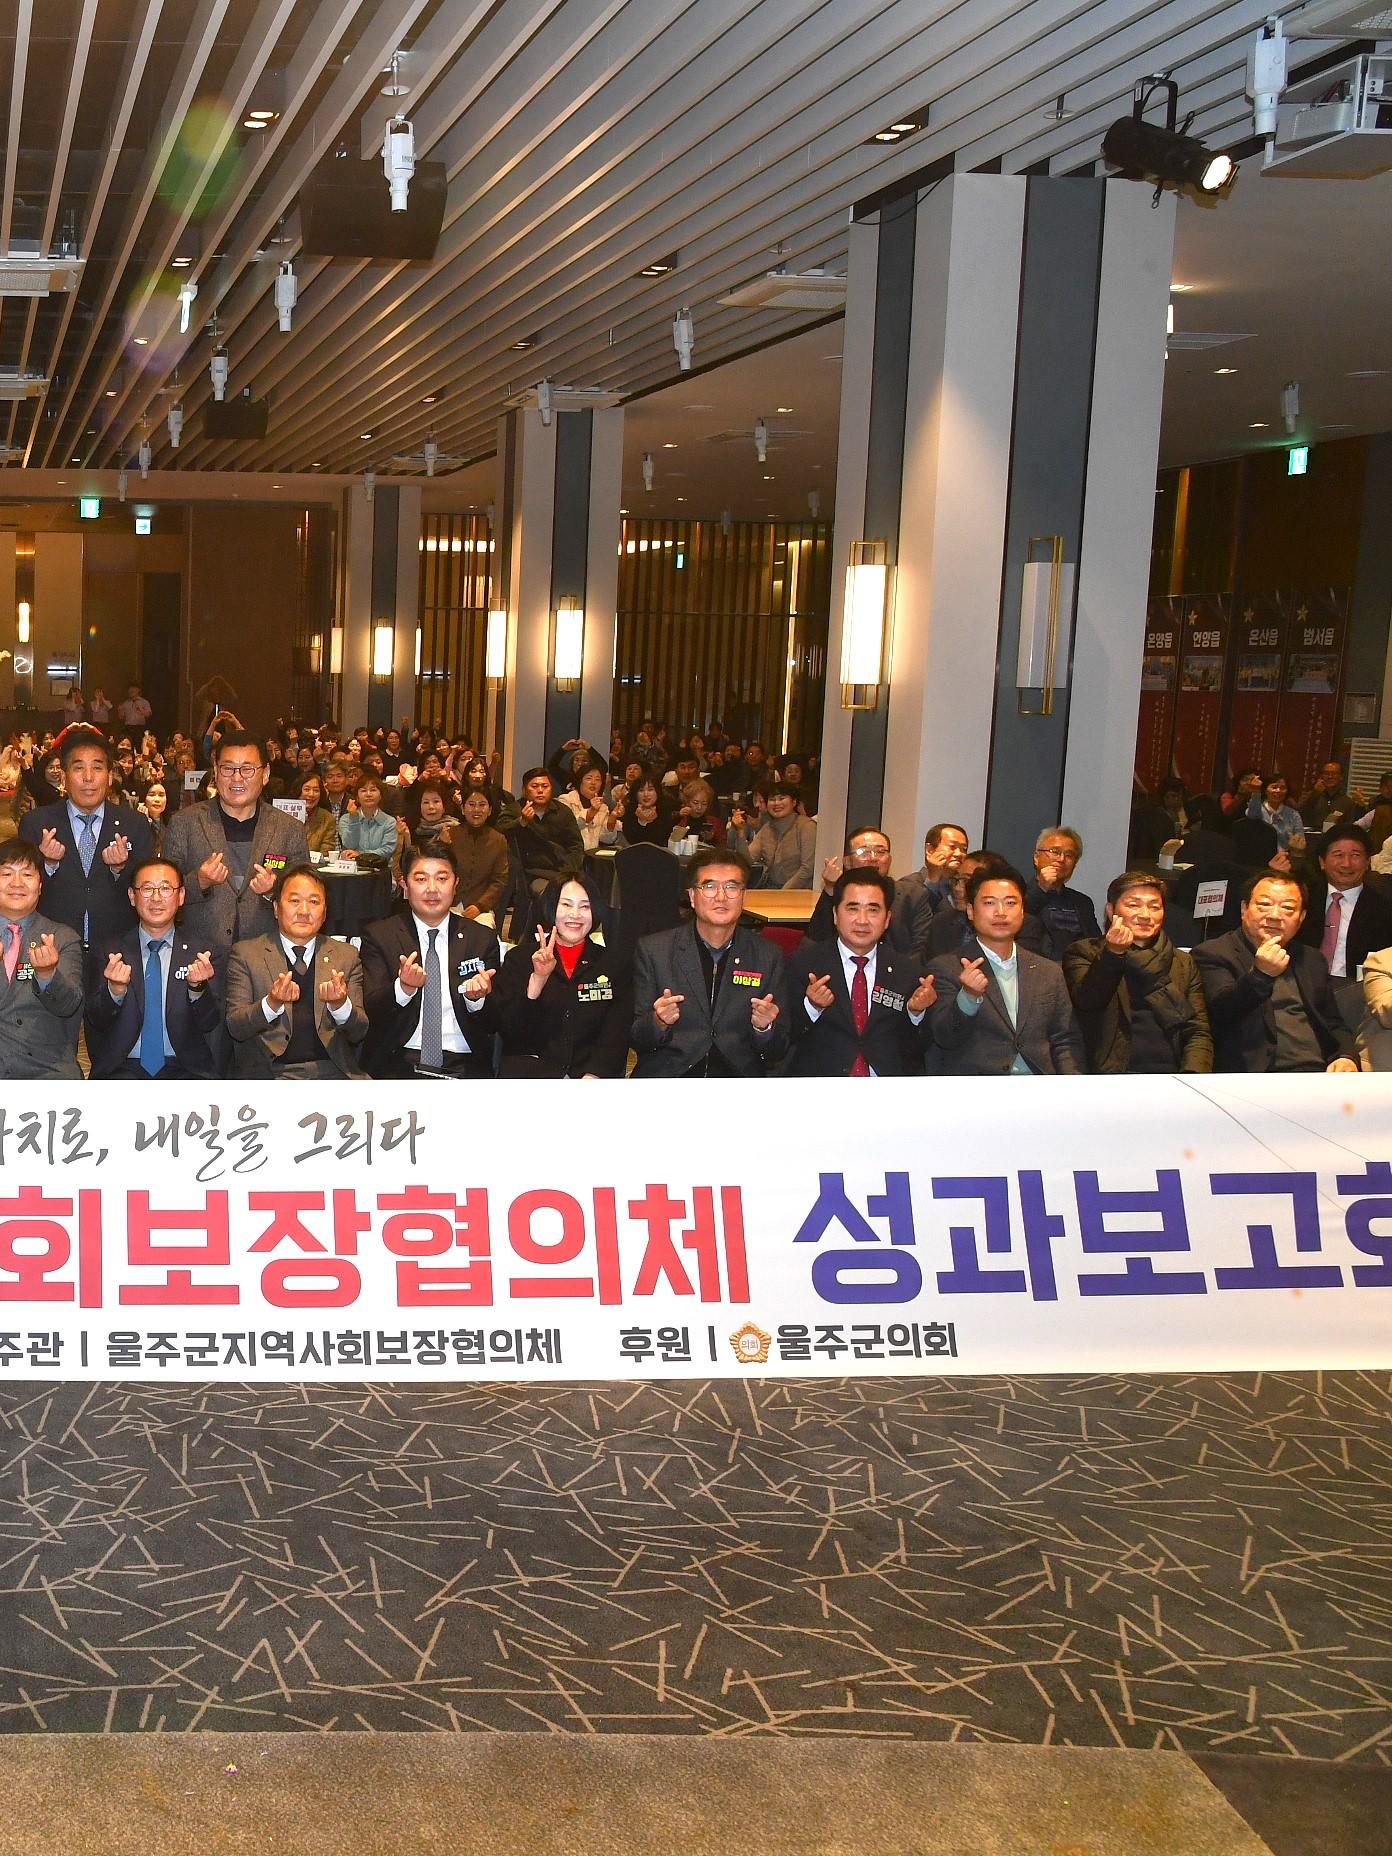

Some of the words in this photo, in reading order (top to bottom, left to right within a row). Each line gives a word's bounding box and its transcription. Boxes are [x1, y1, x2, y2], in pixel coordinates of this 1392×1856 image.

[1248, 628, 1279, 646] 온산읍
[1303, 627, 1335, 646] 범서읍
[578, 989, 613, 1002] 노미경
[135, 1104, 269, 1183] 내일을
[294, 1110, 426, 1166] 그리다
[107, 1327, 563, 1367] 울주군지역사회보장협의체
[620, 1326, 692, 1363] 후원
[776, 1323, 959, 1364] 울주군의회
